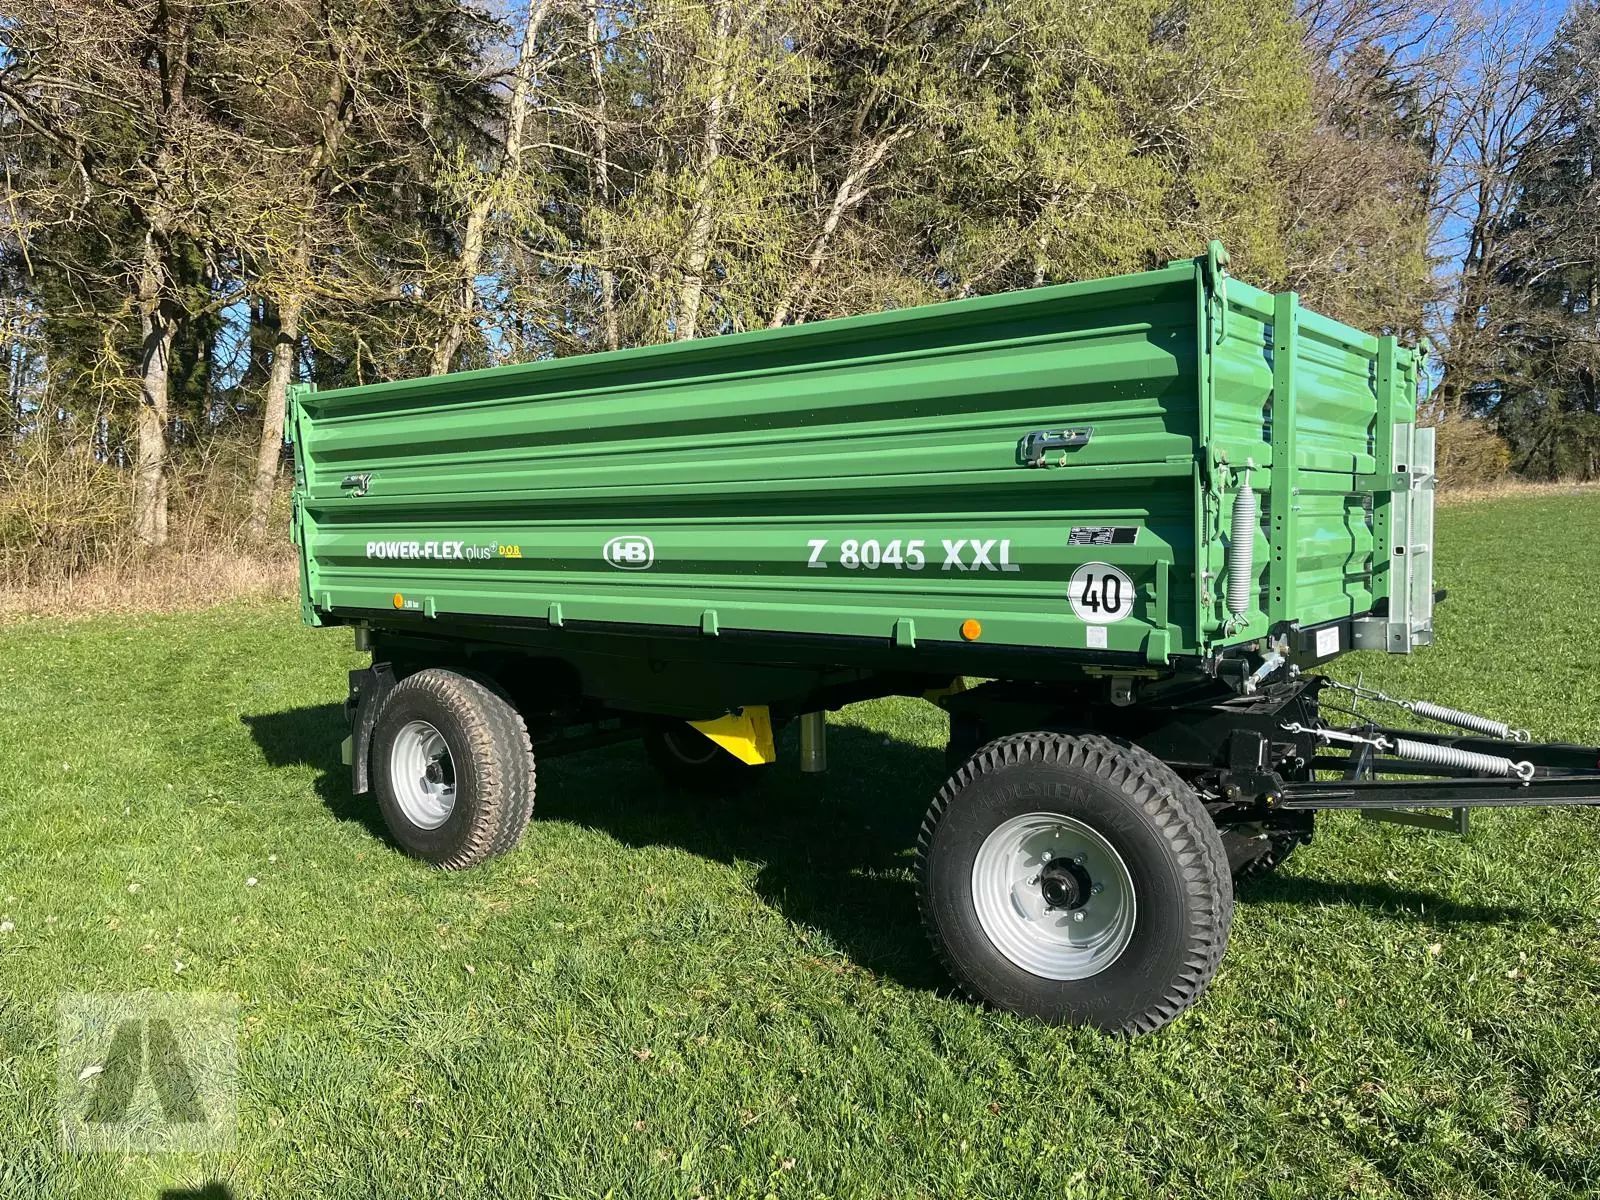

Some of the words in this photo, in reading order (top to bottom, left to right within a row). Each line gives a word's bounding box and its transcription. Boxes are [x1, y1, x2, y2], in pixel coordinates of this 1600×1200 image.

[366, 540, 464, 560] POWER-FLEX
[807, 539, 829, 569] Z
[840, 539, 926, 571] 8045
[940, 539, 1021, 572] XXL
[1081, 573, 1121, 613] 40
